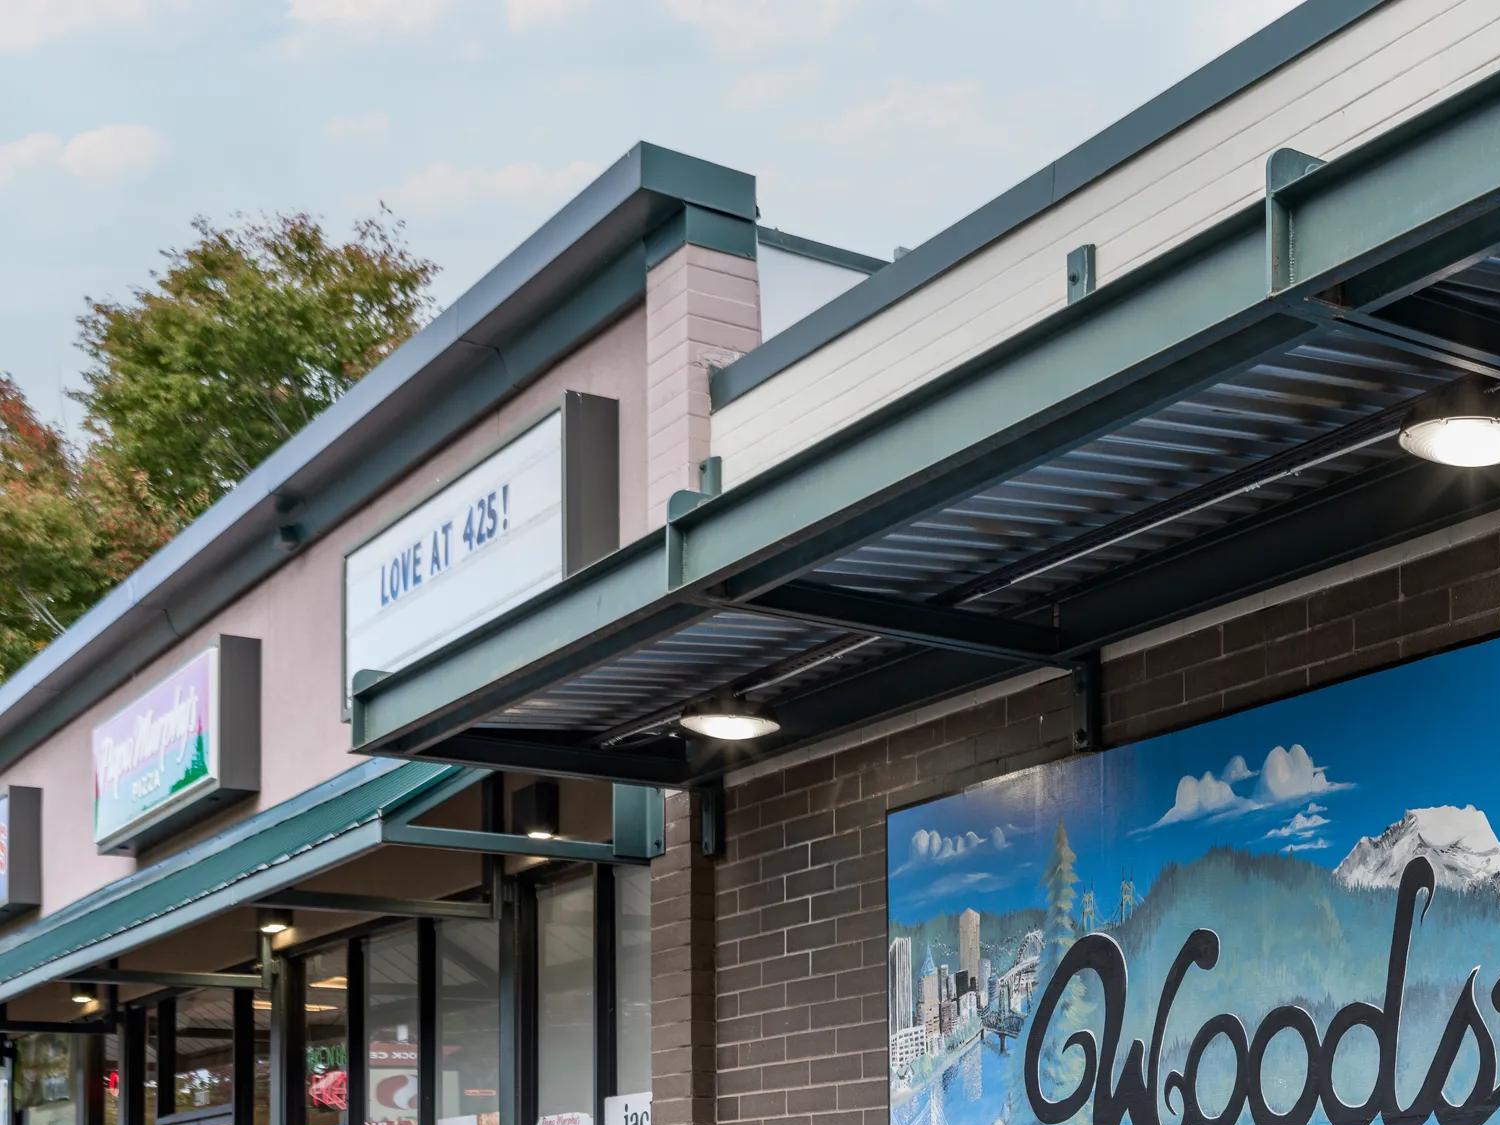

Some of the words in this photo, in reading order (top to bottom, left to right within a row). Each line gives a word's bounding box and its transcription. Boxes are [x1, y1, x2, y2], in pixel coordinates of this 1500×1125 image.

[381, 541, 422, 607] LOVE
[430, 521, 453, 576] AT
[463, 484, 509, 552] 425!
[132, 769, 161, 800] PIZZA
